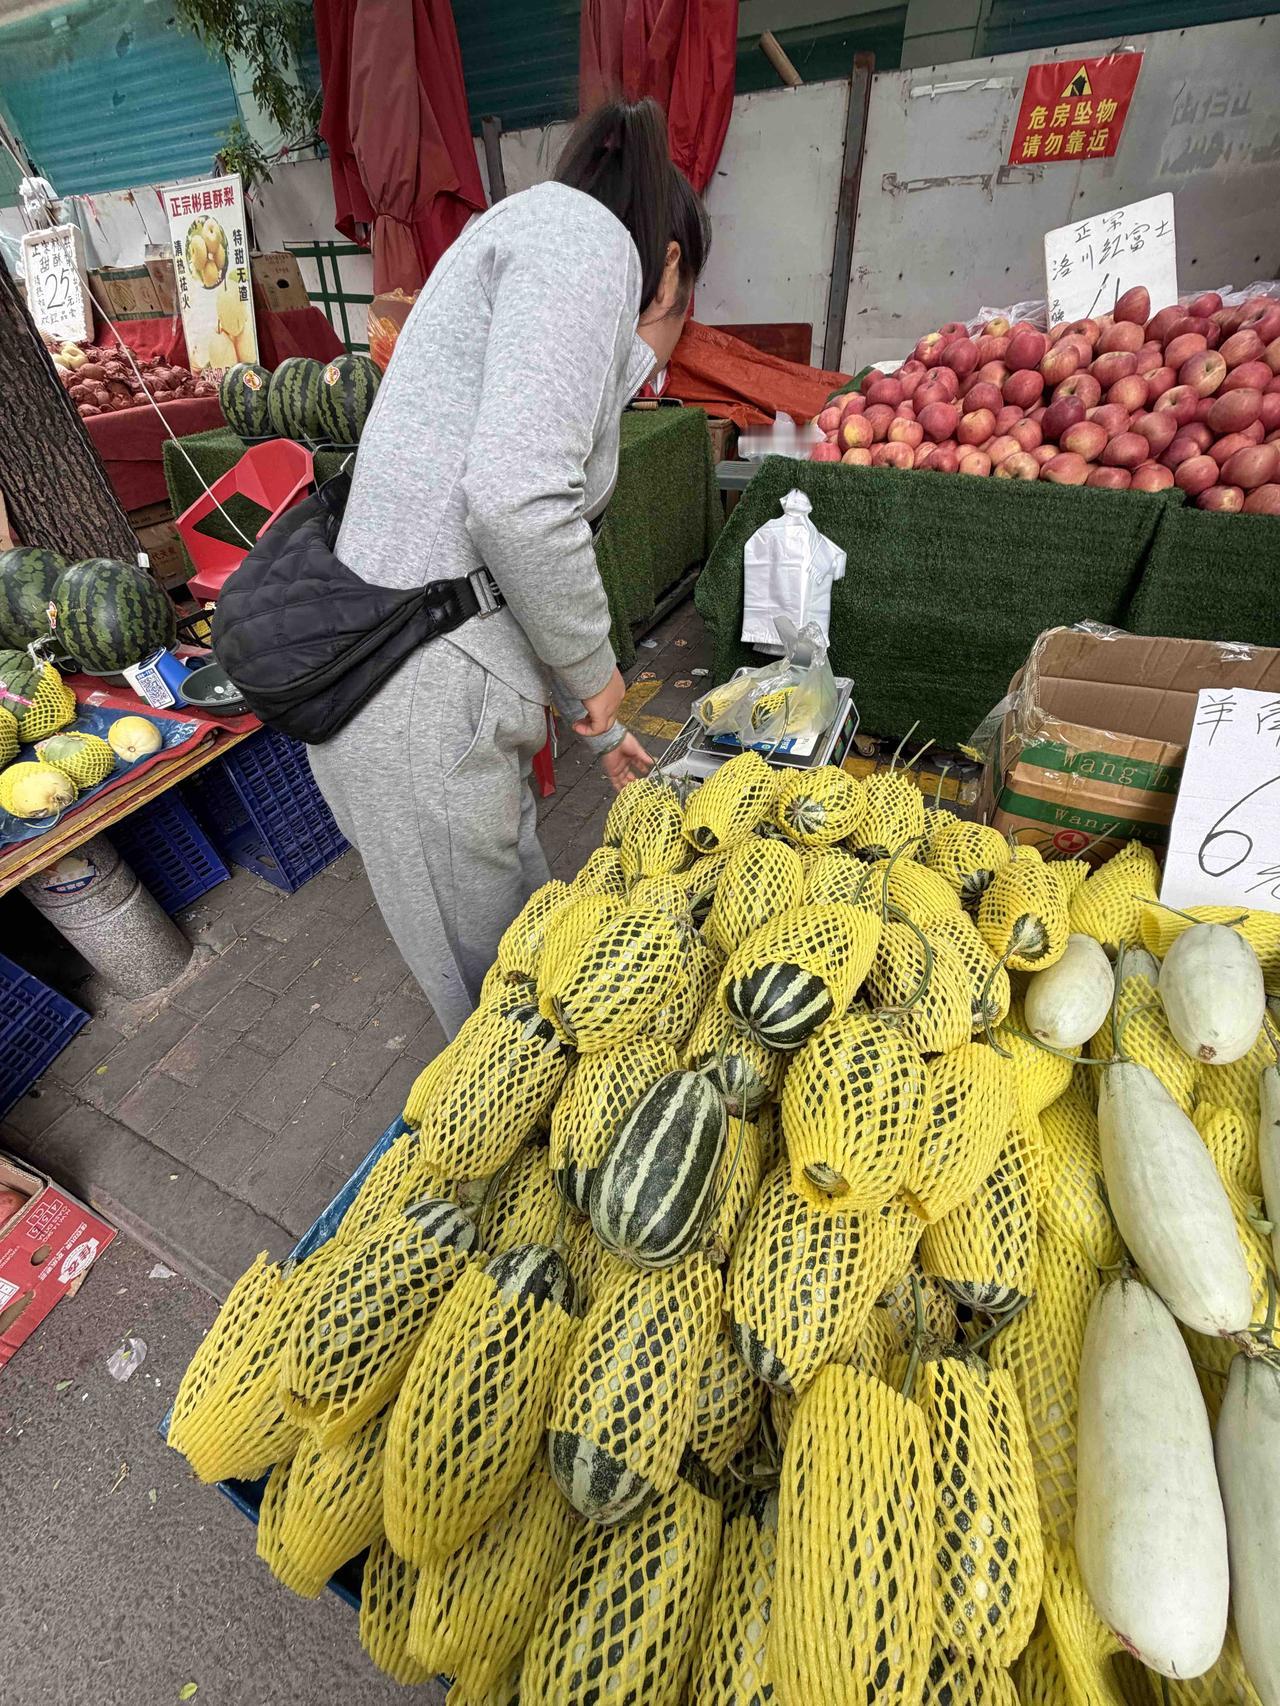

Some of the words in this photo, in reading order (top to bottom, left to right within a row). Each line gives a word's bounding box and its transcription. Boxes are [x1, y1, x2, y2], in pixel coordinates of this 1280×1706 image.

[1028, 98, 1118, 131] 危房坠物
[1021, 128, 1110, 158] 请勿靠近
[170, 185, 235, 217] 正宗彬县酥梨
[1074, 210, 1125, 243] 正宗
[232, 228, 249, 302] 特甜无渣
[1052, 220, 1173, 281] 洛川红富士
[174, 239, 192, 310] 清热祛火
[1063, 746, 1138, 784] Wang
